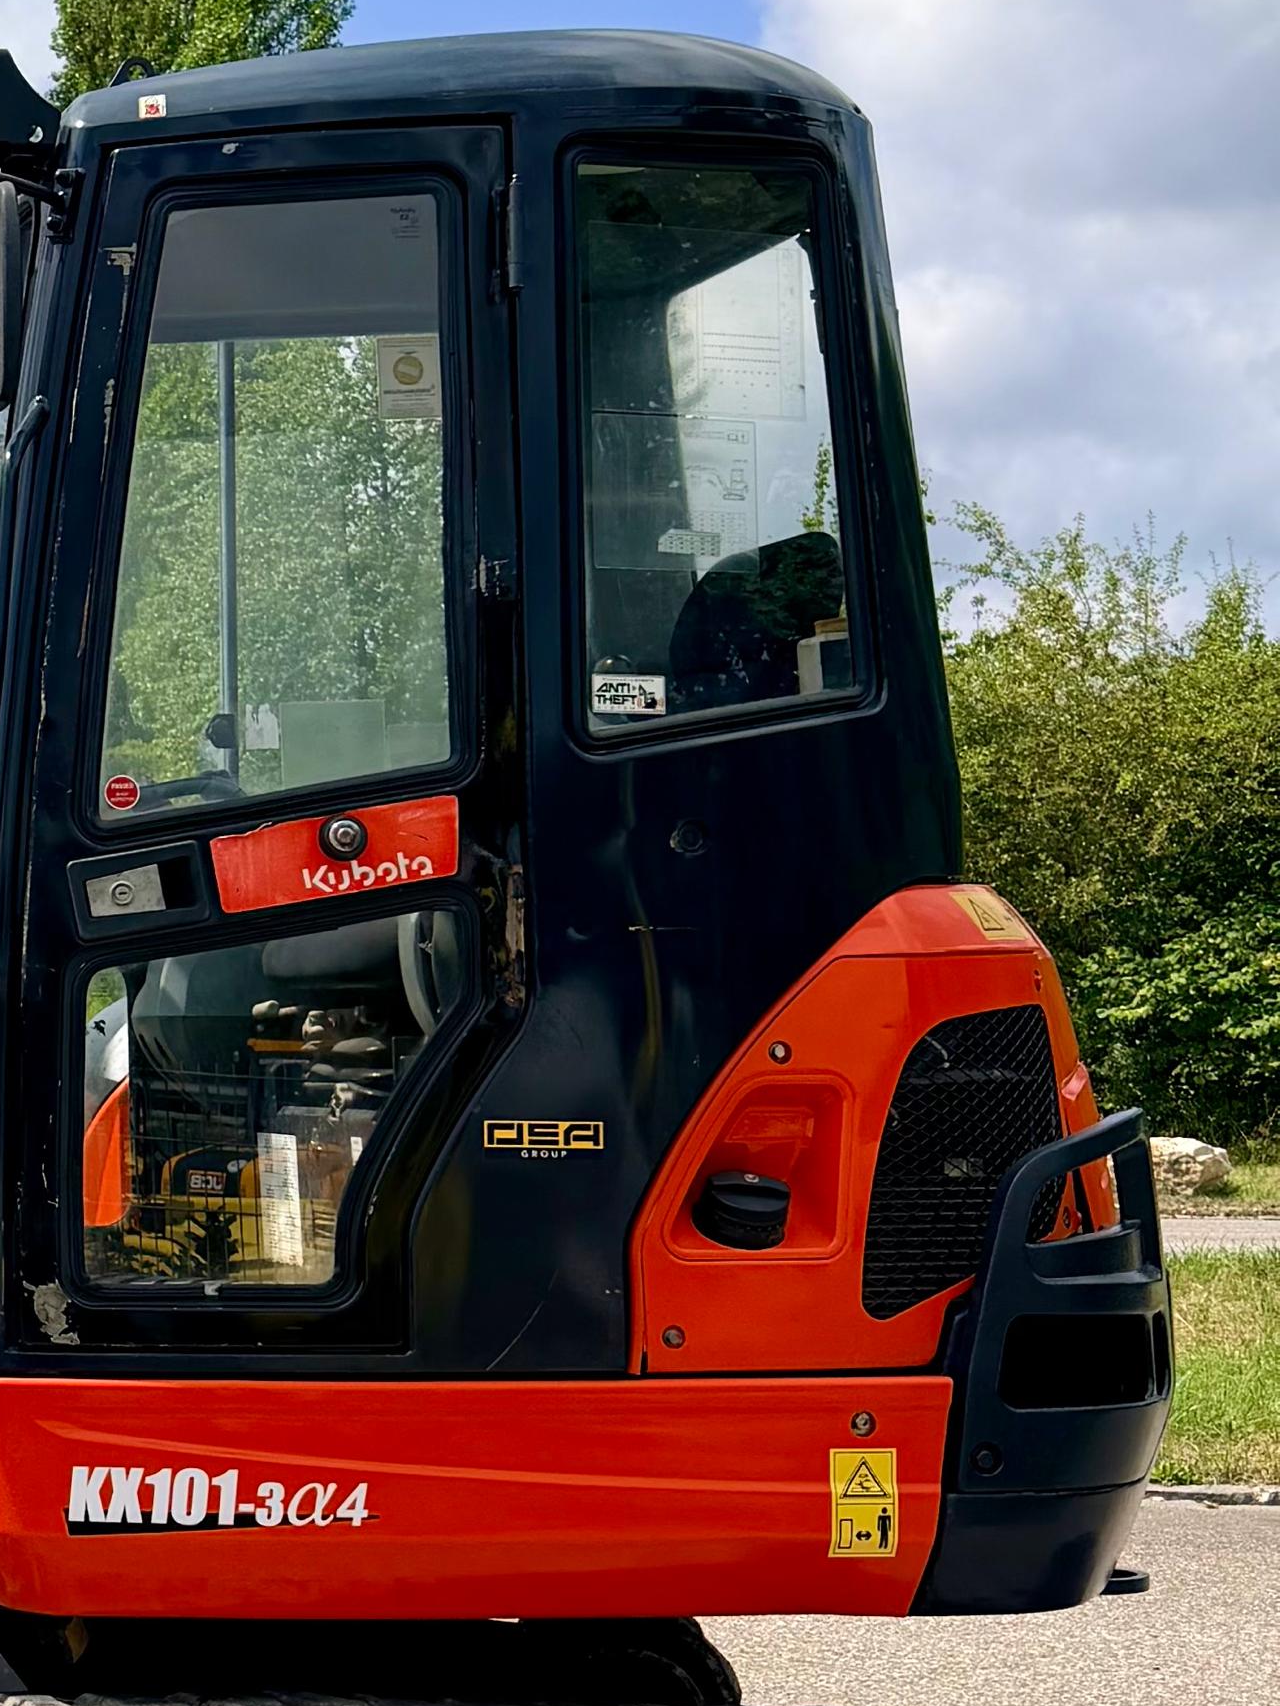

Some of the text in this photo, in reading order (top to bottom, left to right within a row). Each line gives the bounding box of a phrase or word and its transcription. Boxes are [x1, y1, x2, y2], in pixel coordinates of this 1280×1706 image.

[596, 682, 631, 694] ANTI
[594, 694, 638, 705] THEFT
[301, 851, 434, 894] Kubota
[520, 1149, 568, 1159] GROUP
